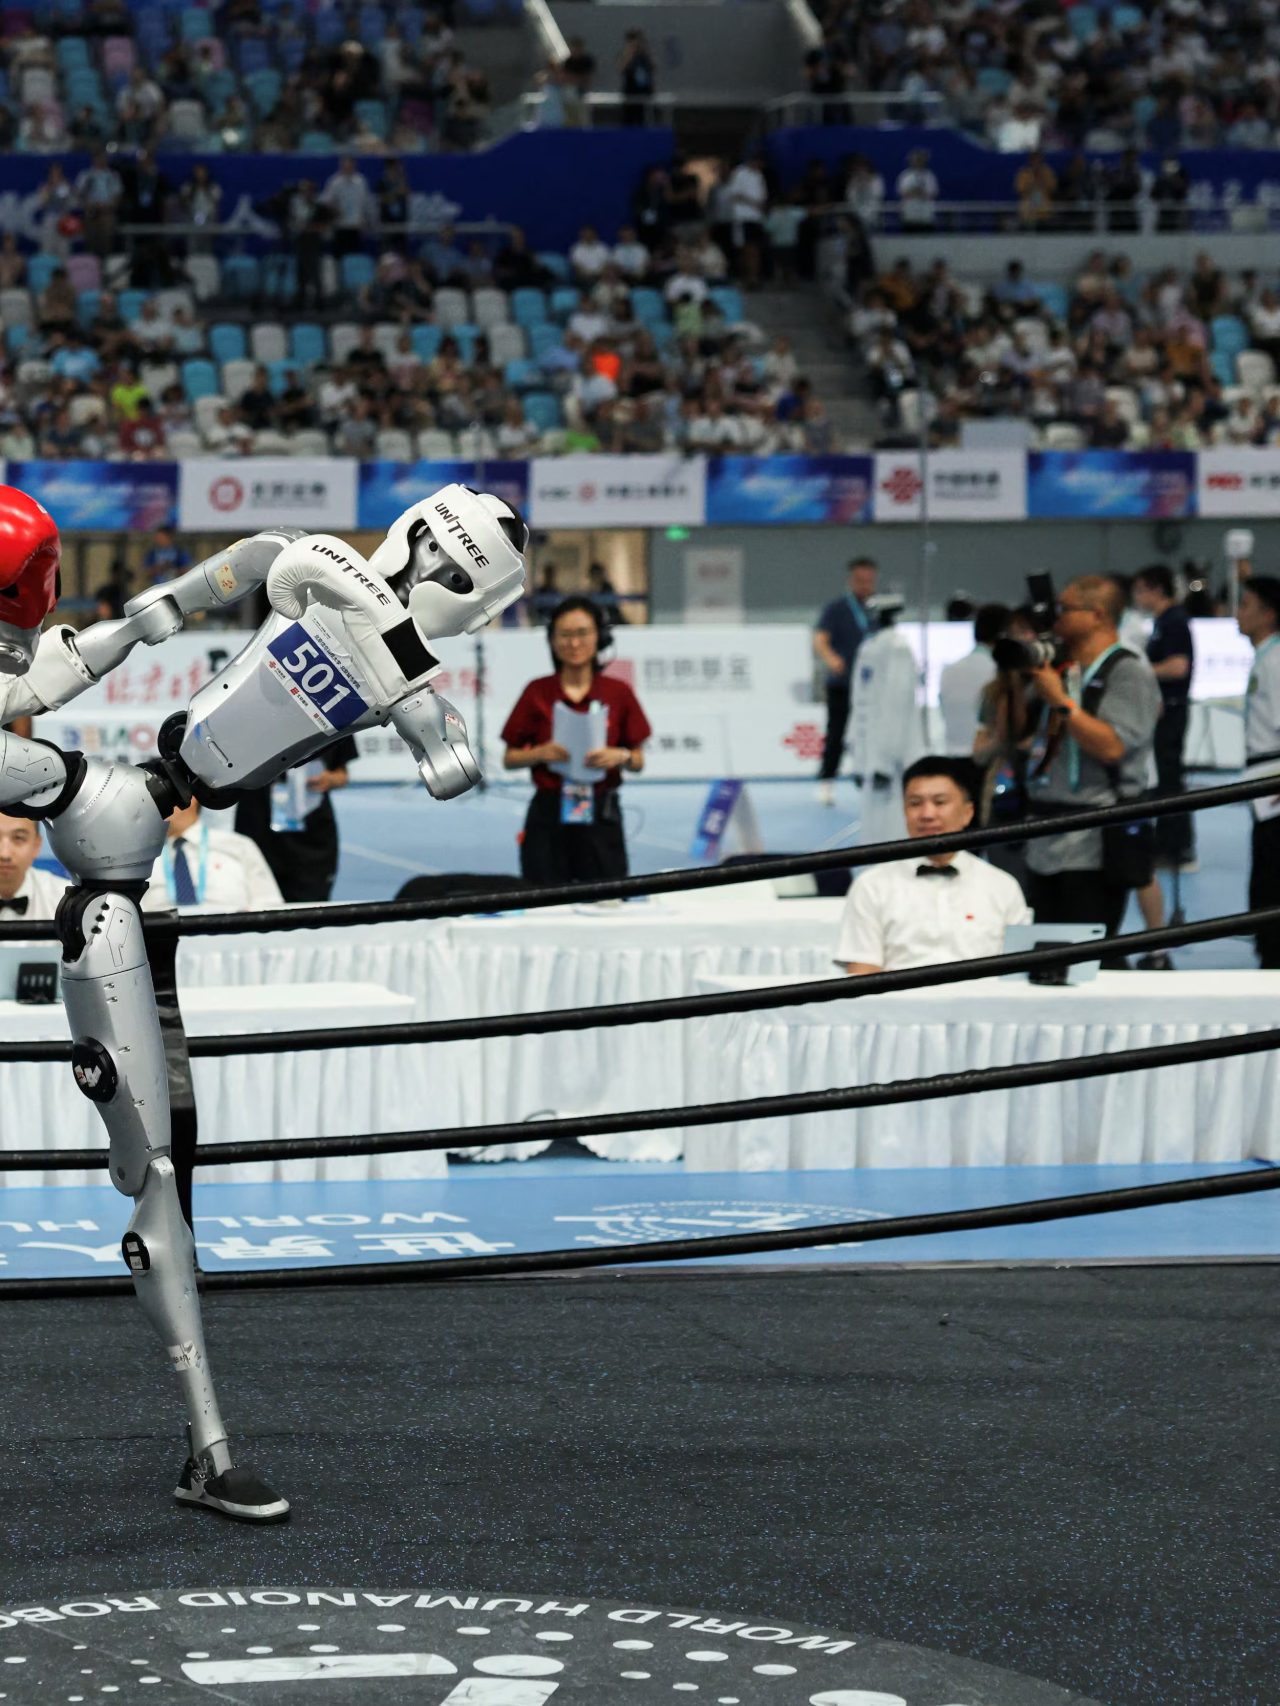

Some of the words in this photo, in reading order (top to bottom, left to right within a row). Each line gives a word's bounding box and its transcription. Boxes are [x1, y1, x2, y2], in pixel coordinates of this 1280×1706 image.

[435, 503, 490, 568] UNITREE
[311, 544, 391, 606] UNITREE
[282, 641, 351, 713] 501
[193, 1211, 471, 1229] WORL
[178, 1591, 590, 1617] HUMANOID
[608, 1608, 857, 1655] WORLD
